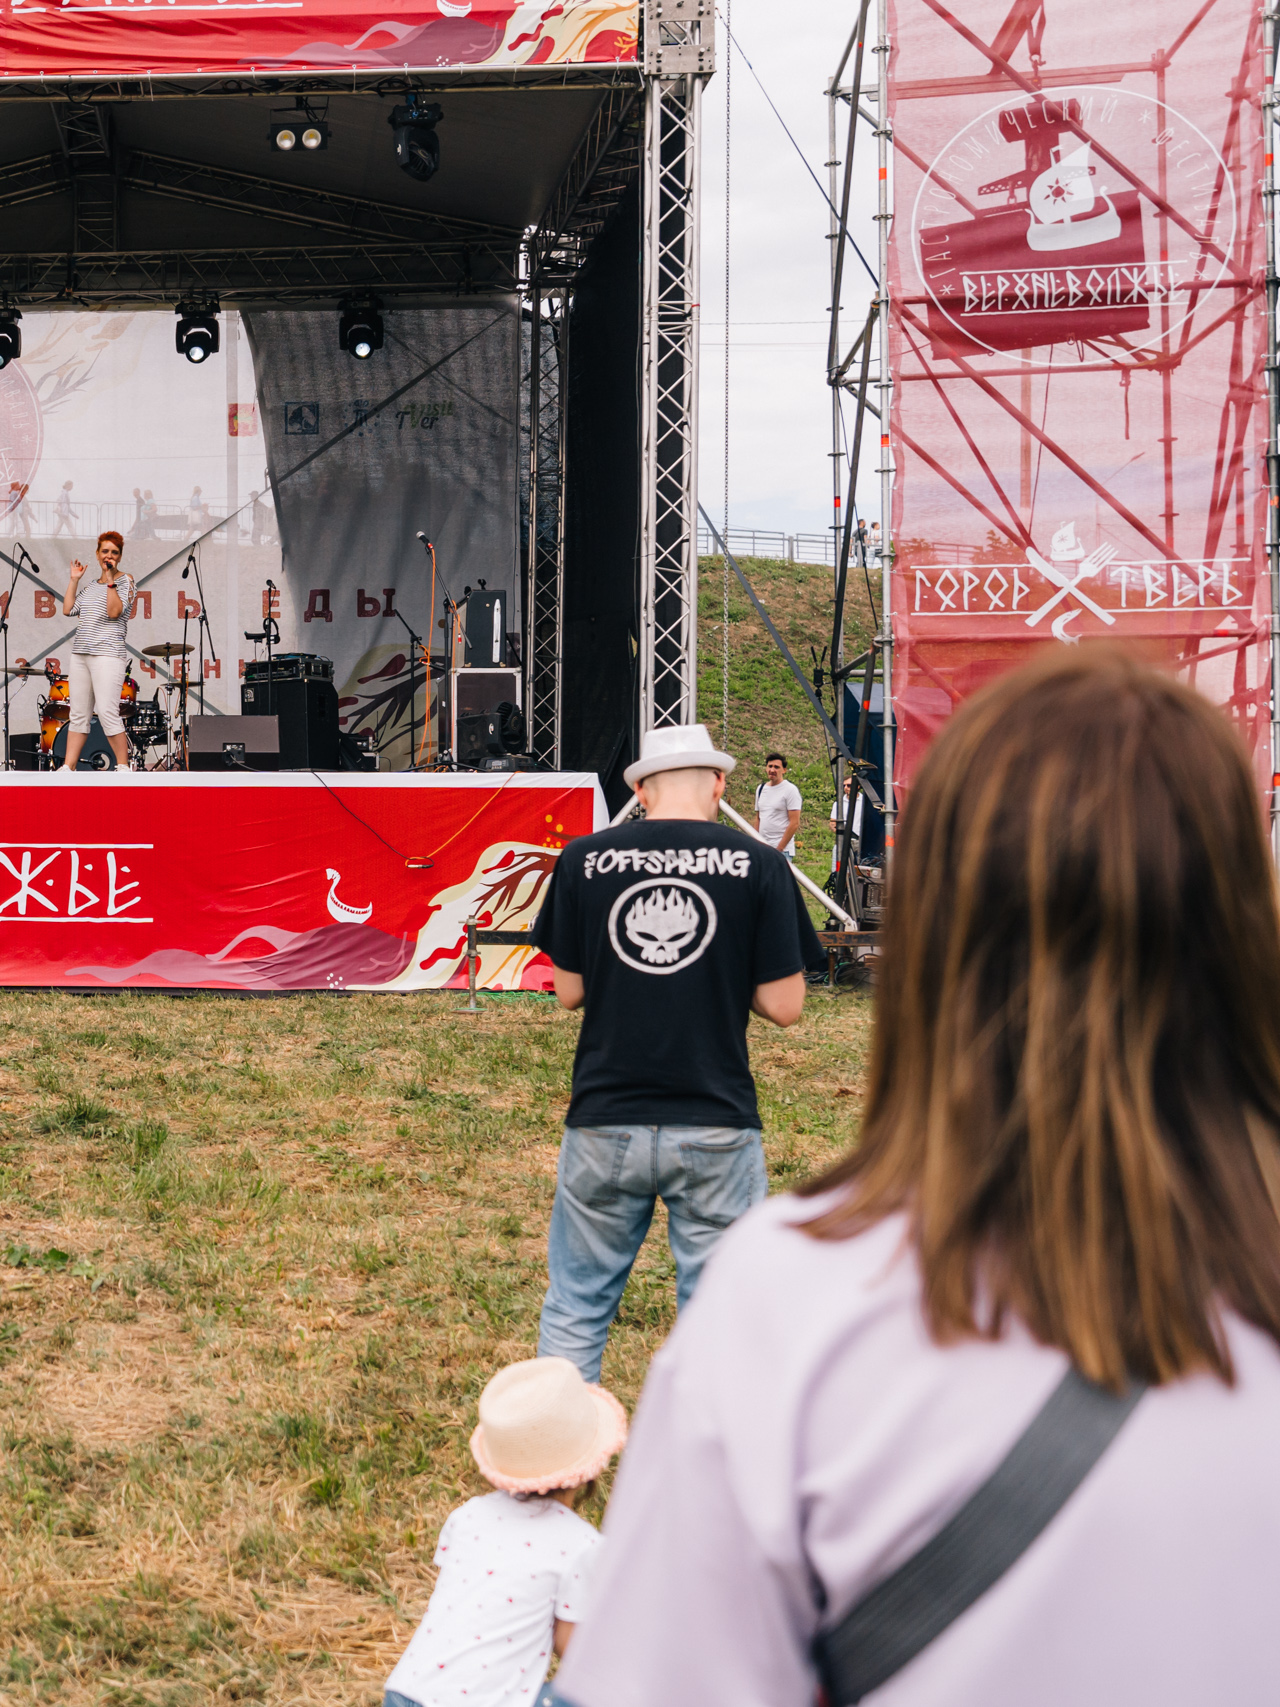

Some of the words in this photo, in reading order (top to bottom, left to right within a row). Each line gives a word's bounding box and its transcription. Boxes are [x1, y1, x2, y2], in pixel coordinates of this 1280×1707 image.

[920, 93, 1118, 279] ГАСТРОНОМИЧЕСКИЙ
[1155, 127, 1222, 262] ФЕСТИВАЛЬ
[962, 265, 1188, 312] ВЕРХНЕВОЛЖЬЕ
[261, 587, 397, 623] ЕДЫ
